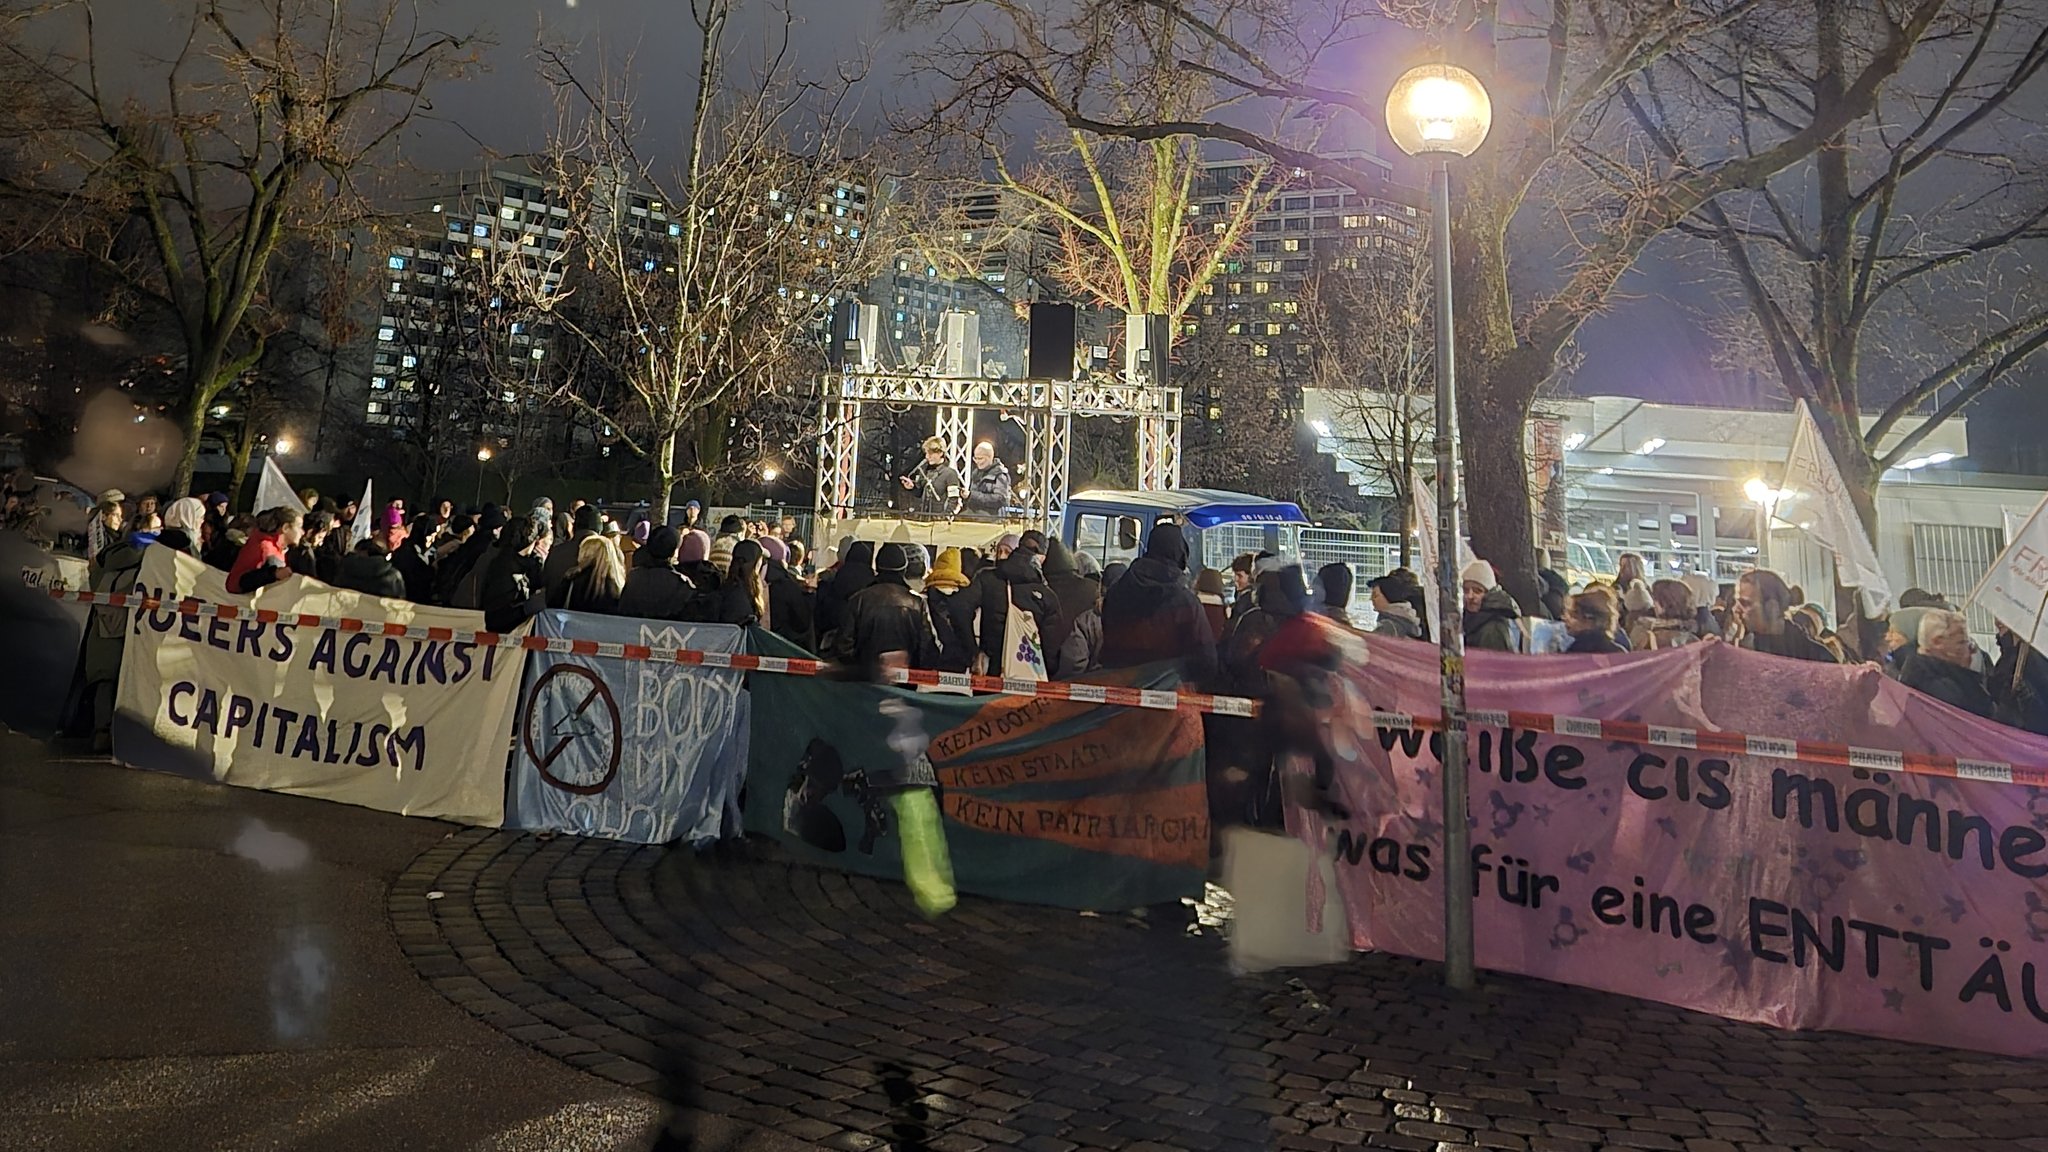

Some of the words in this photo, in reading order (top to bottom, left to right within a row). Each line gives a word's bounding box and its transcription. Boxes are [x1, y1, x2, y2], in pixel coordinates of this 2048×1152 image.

[168, 681, 426, 771] CAPITALISM
[636, 668, 744, 740] BODY
[936, 719, 992, 757] KEIN
[953, 764, 1016, 789] KEIN
[956, 796, 1025, 833] KEIN
[1626, 752, 1732, 810] cis
[1771, 767, 2048, 879] männe
[1331, 827, 1431, 882] was
[1470, 843, 1560, 909] für
[1590, 877, 1719, 944] eine
